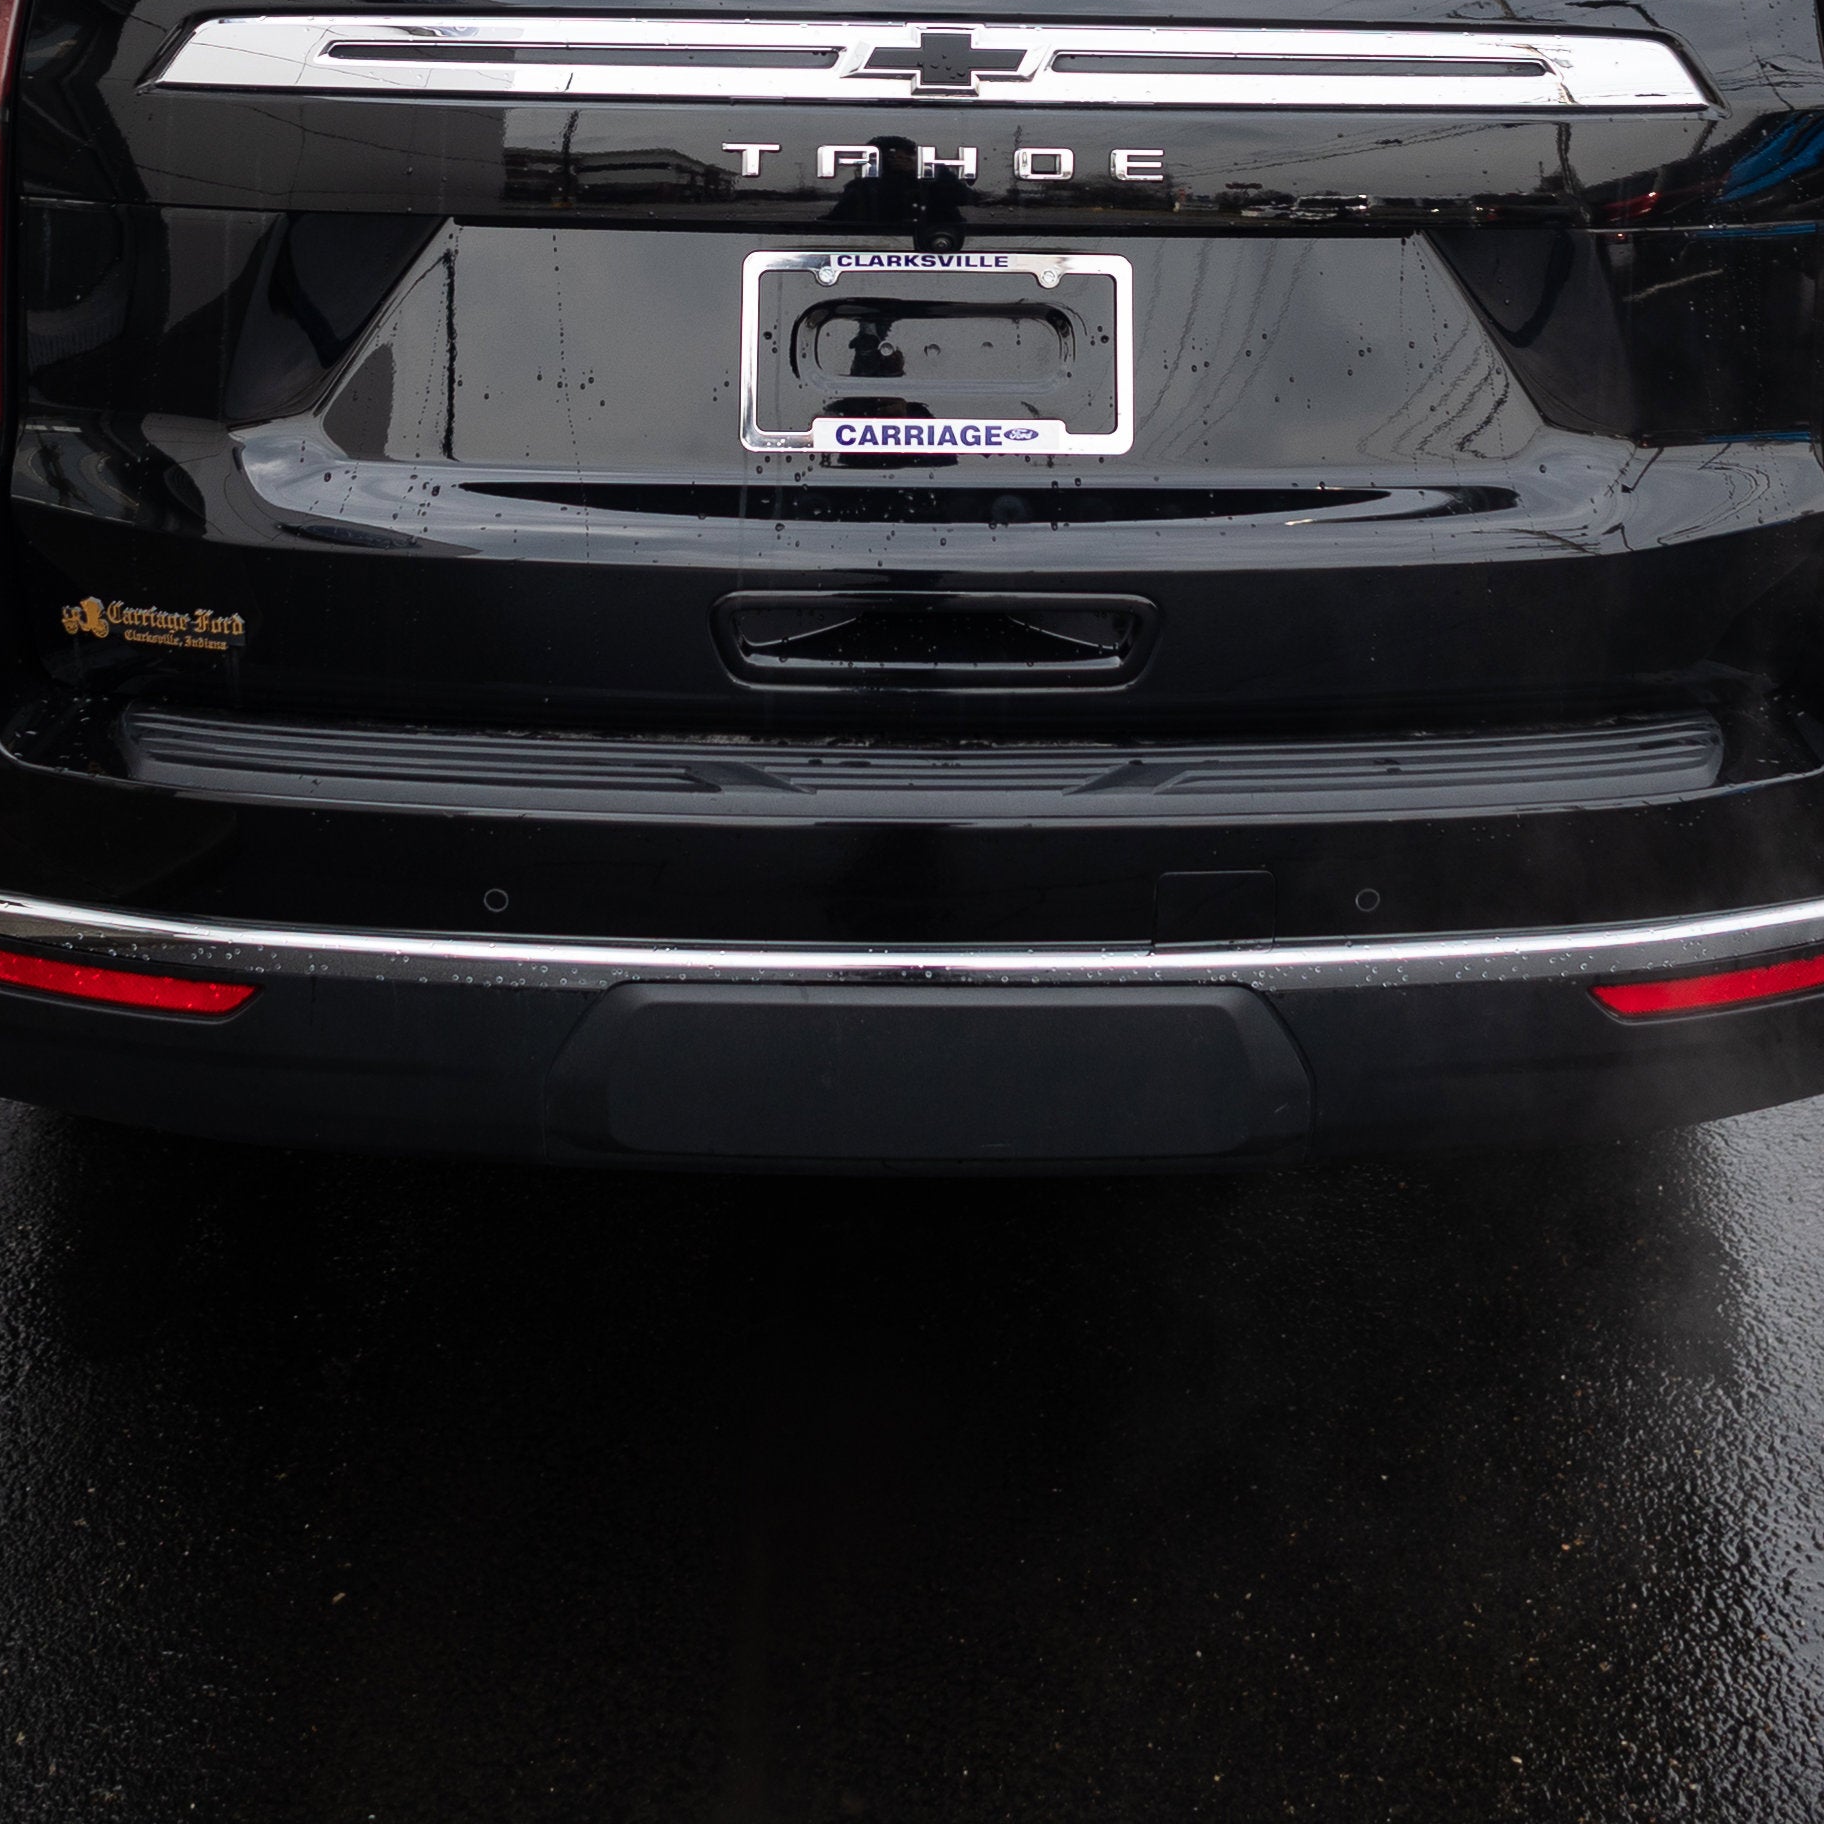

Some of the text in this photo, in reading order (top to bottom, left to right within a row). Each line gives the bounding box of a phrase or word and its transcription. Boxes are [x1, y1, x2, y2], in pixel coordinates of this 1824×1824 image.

[722, 141, 1165, 182] TAHOE
[836, 254, 1009, 268] CLARKSVILLE
[835, 424, 1003, 447] CARRIAGE
[106, 600, 246, 635] Carriage Ford
